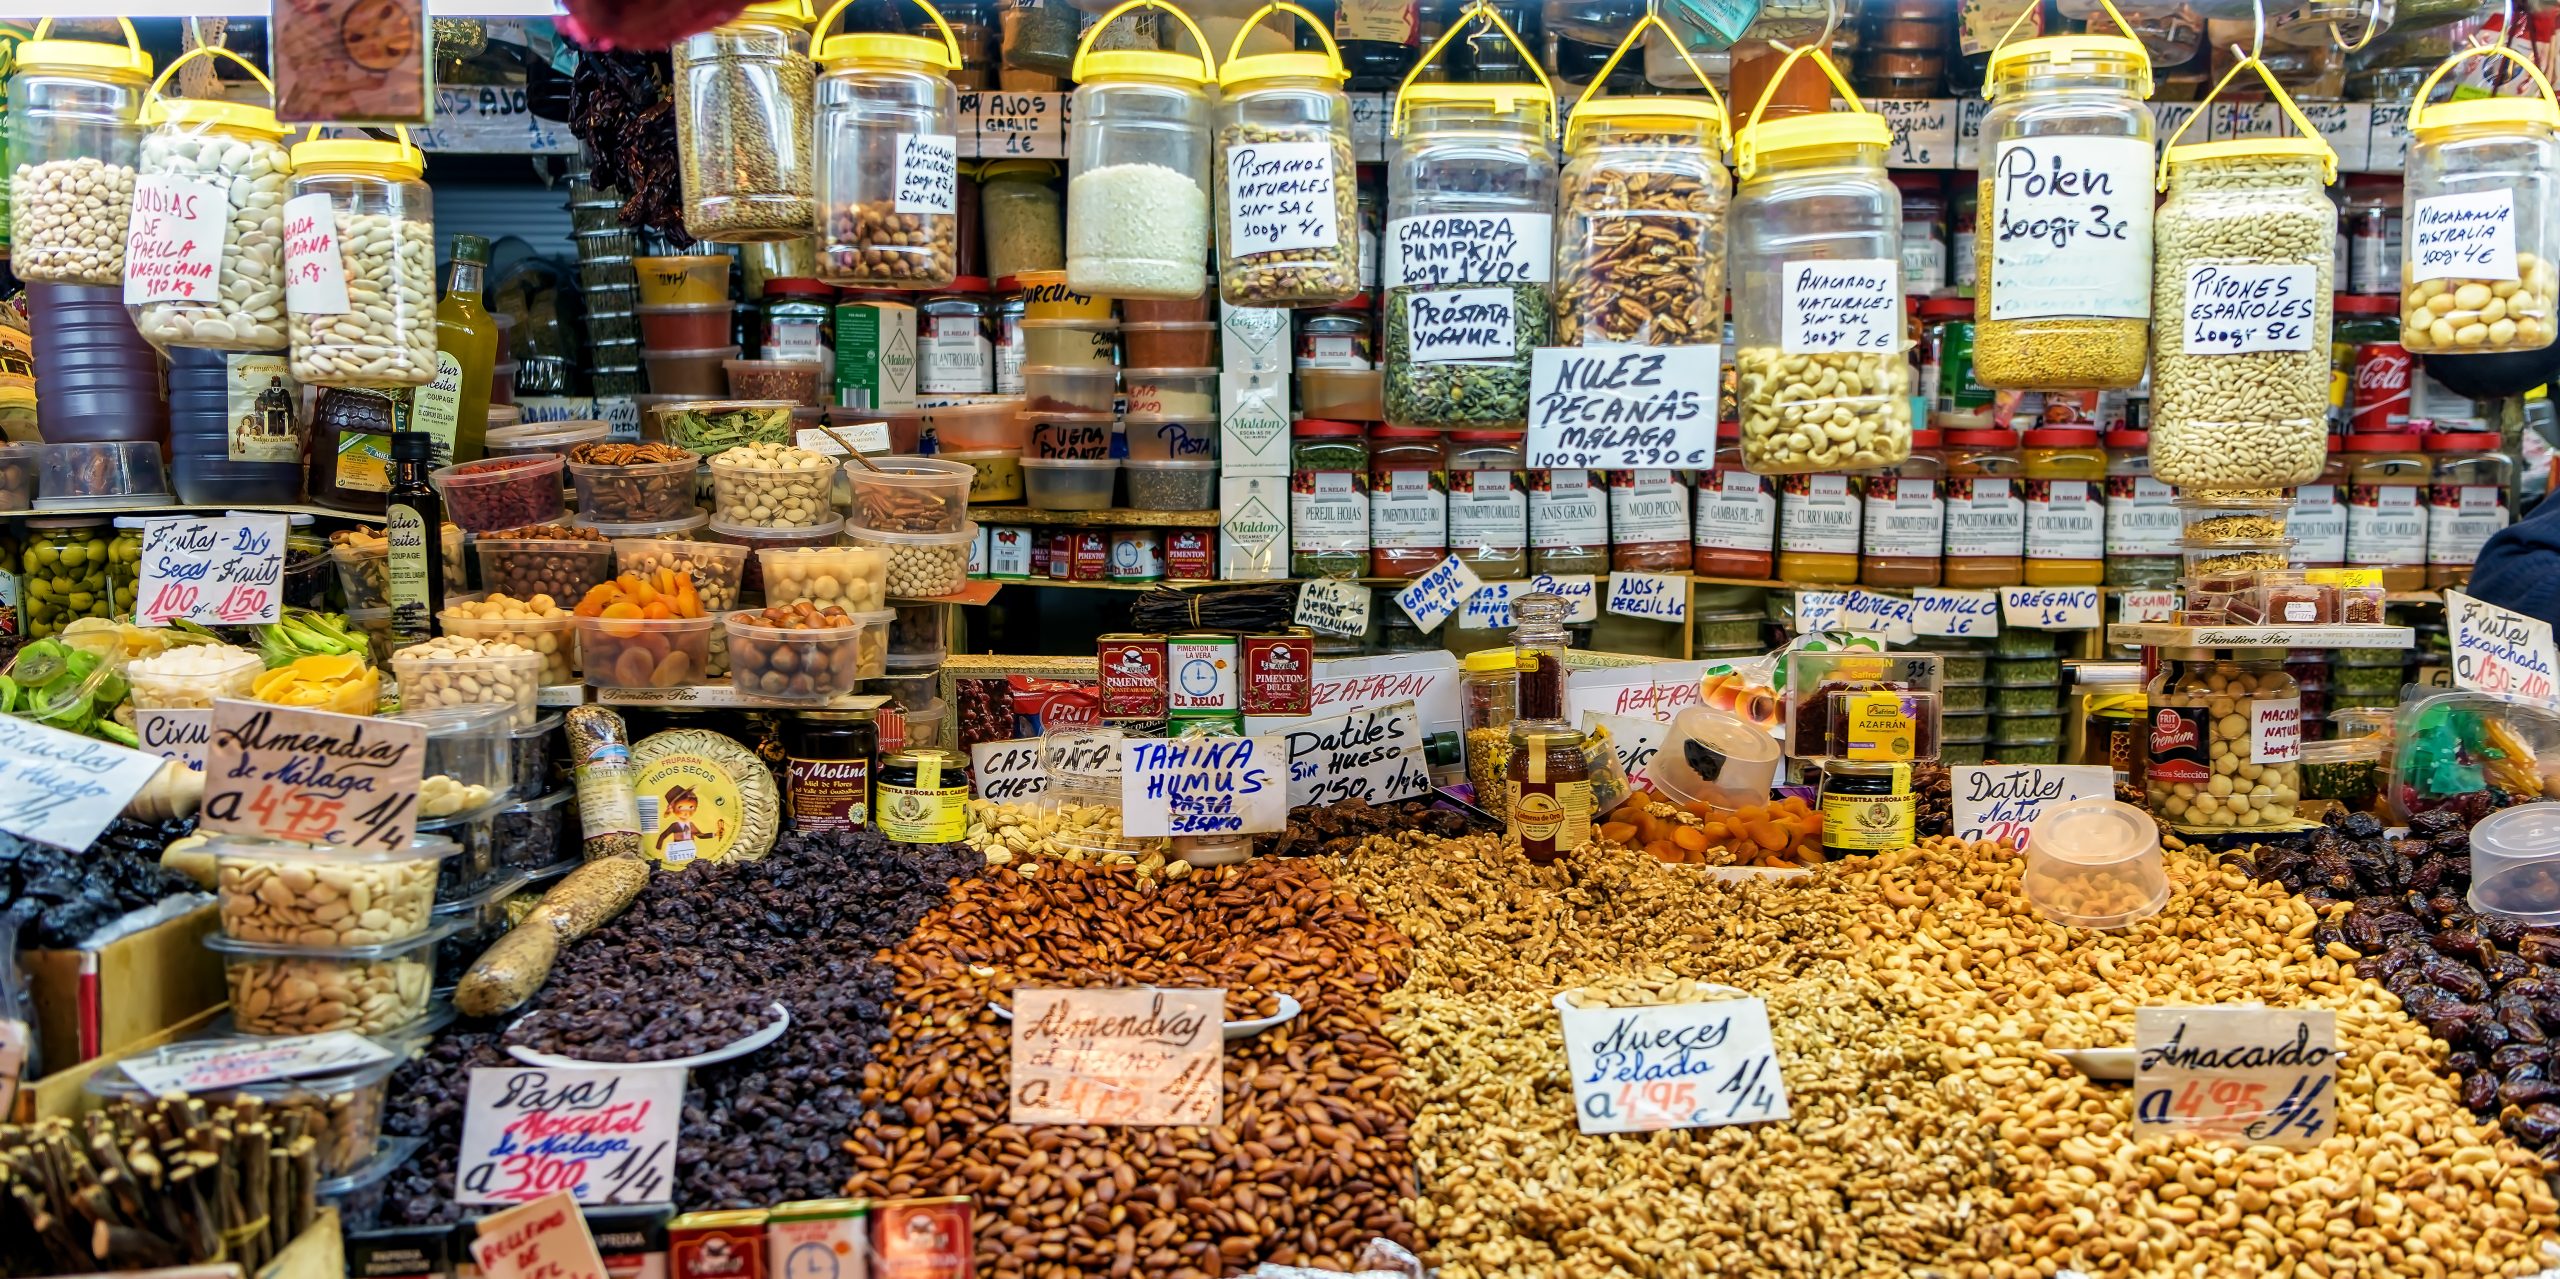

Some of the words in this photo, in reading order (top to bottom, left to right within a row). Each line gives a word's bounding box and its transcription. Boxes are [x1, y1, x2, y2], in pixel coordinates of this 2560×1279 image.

[990, 96, 1046, 116] AJOS
[1881, 100, 1930, 114] PASTA
[985, 117, 1039, 132] GARLIC
[1006, 132, 1035, 153] 1€
[1238, 178, 1330, 200] NATURALES
[143, 217, 161, 237] DE
[1400, 217, 1516, 242] CALABAZA
[1401, 239, 1517, 262] PUMPKIN
[1798, 296, 1894, 310] NATURALES
[2190, 300, 2313, 321] ESPAÑOLES
[886, 354, 913, 366] Maldon
[928, 350, 961, 367] CILANTRO
[963, 351, 985, 368] HOJAS
[1555, 354, 1666, 396] NUEZ
[2359, 356, 2411, 390] Cola
[427, 393, 454, 404] COUPAGE
[1535, 390, 1700, 429] PECANAS
[1231, 416, 1281, 429] Maldon
[1648, 478, 1667, 486] RELOJ
[1305, 506, 1335, 522] PEREJIL
[1337, 506, 1361, 521] HOJAS
[1411, 508, 1429, 522] DULCE
[1540, 506, 1563, 521] ANIS
[1564, 504, 1597, 519] GRANO
[1628, 503, 1654, 517] MOJO
[1656, 499, 1683, 515] PICON
[1711, 505, 1739, 520] GAMBAS
[1797, 509, 1822, 524] CURRY
[1823, 511, 1852, 525] MADRAS
[1230, 521, 1280, 534] Maldon
[2122, 513, 2156, 527] CILANTRO
[1078, 551, 1106, 560] PIMENTON
[1169, 551, 1206, 559] PIMENTON
[148, 557, 212, 588] Secas
[1114, 567, 1121, 576] EL
[1402, 557, 1460, 611] GAMBAS
[1440, 578, 1464, 601] PIL
[1532, 572, 1592, 597] PAELLA
[1913, 593, 1999, 615] TOMILLO
[2128, 595, 2172, 608] SESAMO
[1946, 616, 1973, 635] 1€
[2041, 609, 2068, 625] 1€
[2197, 631, 2258, 645] Primitivo
[1107, 677, 1157, 687] PIMENTON
[1255, 674, 1303, 684] PIMENTON
[1851, 670, 1883, 679] Saffron
[602, 688, 664, 700] Primitivo
[1174, 693, 1189, 707] EL
[1190, 693, 1225, 707] RELOJ
[1048, 702, 1097, 721] FRIT
[2160, 714, 2176, 724] FRIT
[1858, 719, 1907, 729] AZAFRÁN
[1284, 713, 1405, 765] Datiles
[228, 752, 256, 781] de
[661, 757, 704, 767] FRUPASAN
[1328, 746, 1401, 775] HUESO
[649, 766, 681, 786] HIGOS
[682, 766, 716, 783] SECOS
[804, 762, 867, 780] Molina
[2174, 769, 2209, 780] Selección
[904, 788, 934, 797] SEÑORA
[1147, 769, 1266, 800] HUMUS
[1966, 768, 2066, 802] Datiles
[1169, 794, 1232, 814] PASTA
[1840, 795, 1874, 803] NUESTRA
[1875, 793, 1902, 803] SEÑORA
[207, 790, 242, 823] a
[353, 792, 418, 851] 1/4
[1171, 814, 1243, 833] SESAMO
[1517, 811, 1541, 822] Colmena
[1541, 814, 1549, 822] de
[1550, 812, 1561, 821] Oro
[1592, 1013, 1732, 1061] Nueces
[2140, 1021, 2337, 1072] Anacardo
[1583, 1090, 1617, 1119] a
[1716, 1054, 1775, 1119] 1/4
[2138, 1088, 2172, 1125] a
[2266, 1074, 2332, 1138] 1/4
[504, 1101, 652, 1142] Moscatel
[489, 1133, 520, 1156] de
[463, 1161, 498, 1194] a
[603, 1141, 670, 1199] 1/4
[516, 1243, 542, 1270] DE
